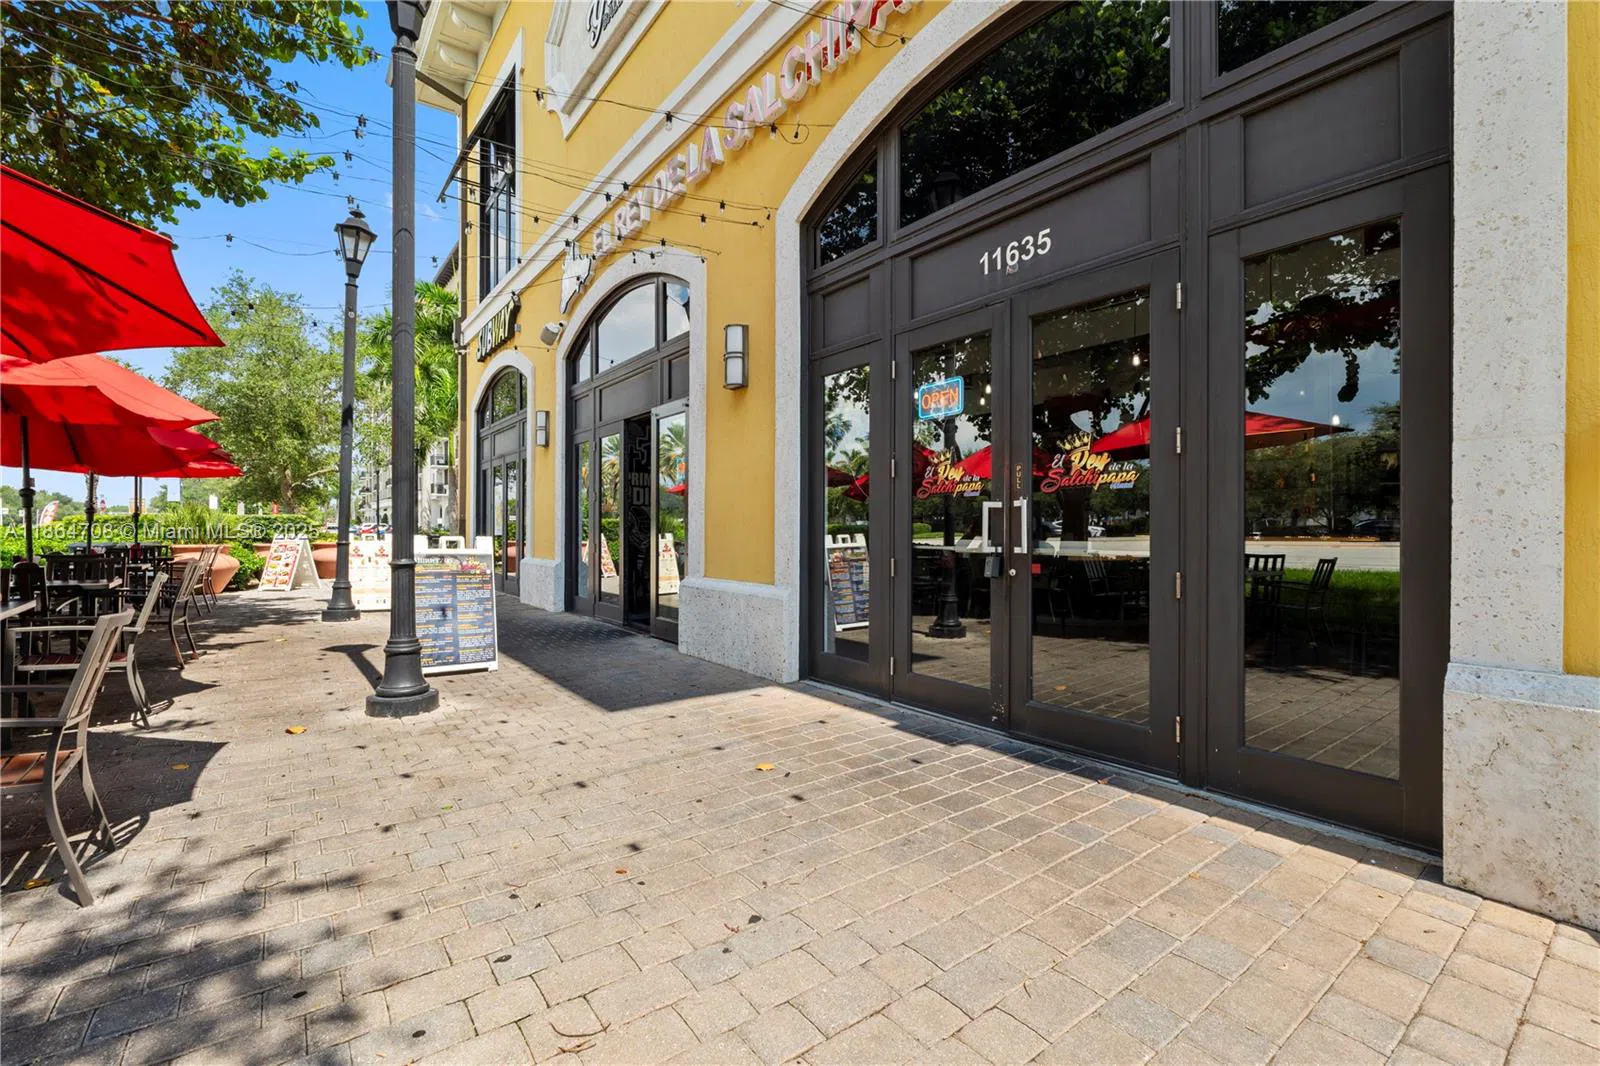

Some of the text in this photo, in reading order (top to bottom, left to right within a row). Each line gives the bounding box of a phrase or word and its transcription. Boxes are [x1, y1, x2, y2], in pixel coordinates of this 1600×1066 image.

[614, 182, 651, 245] REY
[653, 152, 687, 209] DE
[686, 126, 725, 183] LA
[979, 227, 1052, 276] 11635
[475, 298, 515, 361] SUBWAY
[921, 385, 959, 410] OPEN
[1040, 467, 1140, 494] Salchipapa
[1051, 450, 1135, 476] El Rey de la
